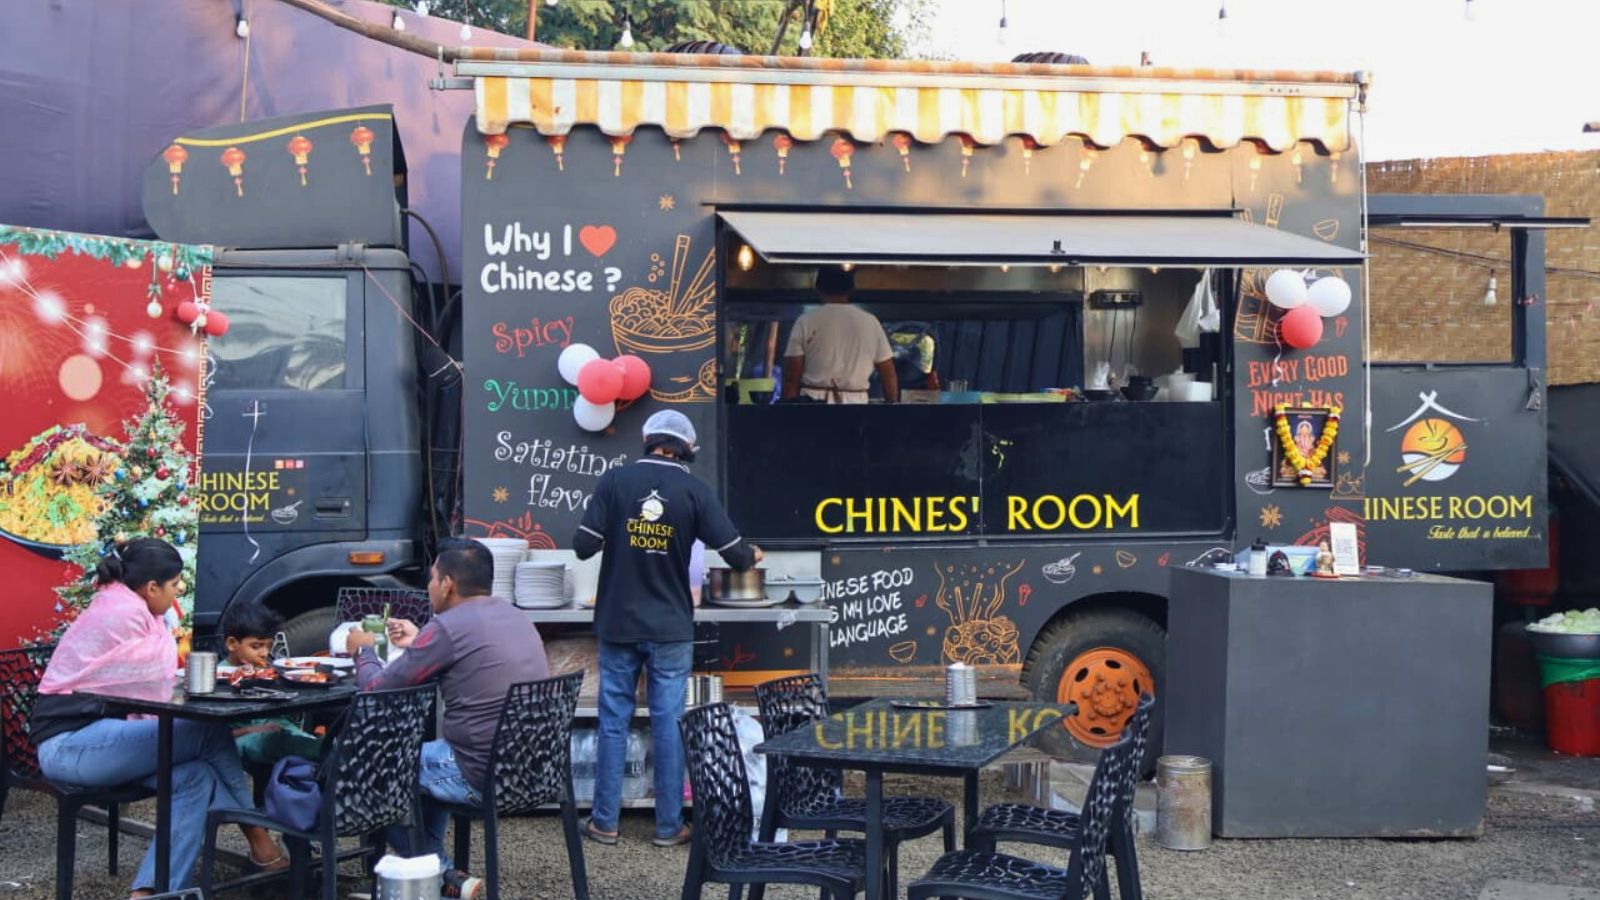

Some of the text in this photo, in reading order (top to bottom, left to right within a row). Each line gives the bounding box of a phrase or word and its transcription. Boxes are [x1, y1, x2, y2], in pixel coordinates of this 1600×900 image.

[484, 221, 572, 261] Why I
[480, 261, 622, 293] Chinese ?
[491, 316, 575, 358] Spicy
[1248, 355, 1348, 388] EVERY GOOD
[200, 472, 280, 491] HINESE
[198, 492, 270, 511] ROOM
[1007, 494, 1140, 530] ROOM
[1449, 495, 1533, 519] ROOM
[626, 518, 675, 537] CHINESE
[630, 535, 668, 550] ROOM
[871, 566, 914, 592] FOOD
[843, 600, 864, 621] MY
[867, 591, 903, 616] LOVE
[829, 612, 909, 648] LANGUAGE
